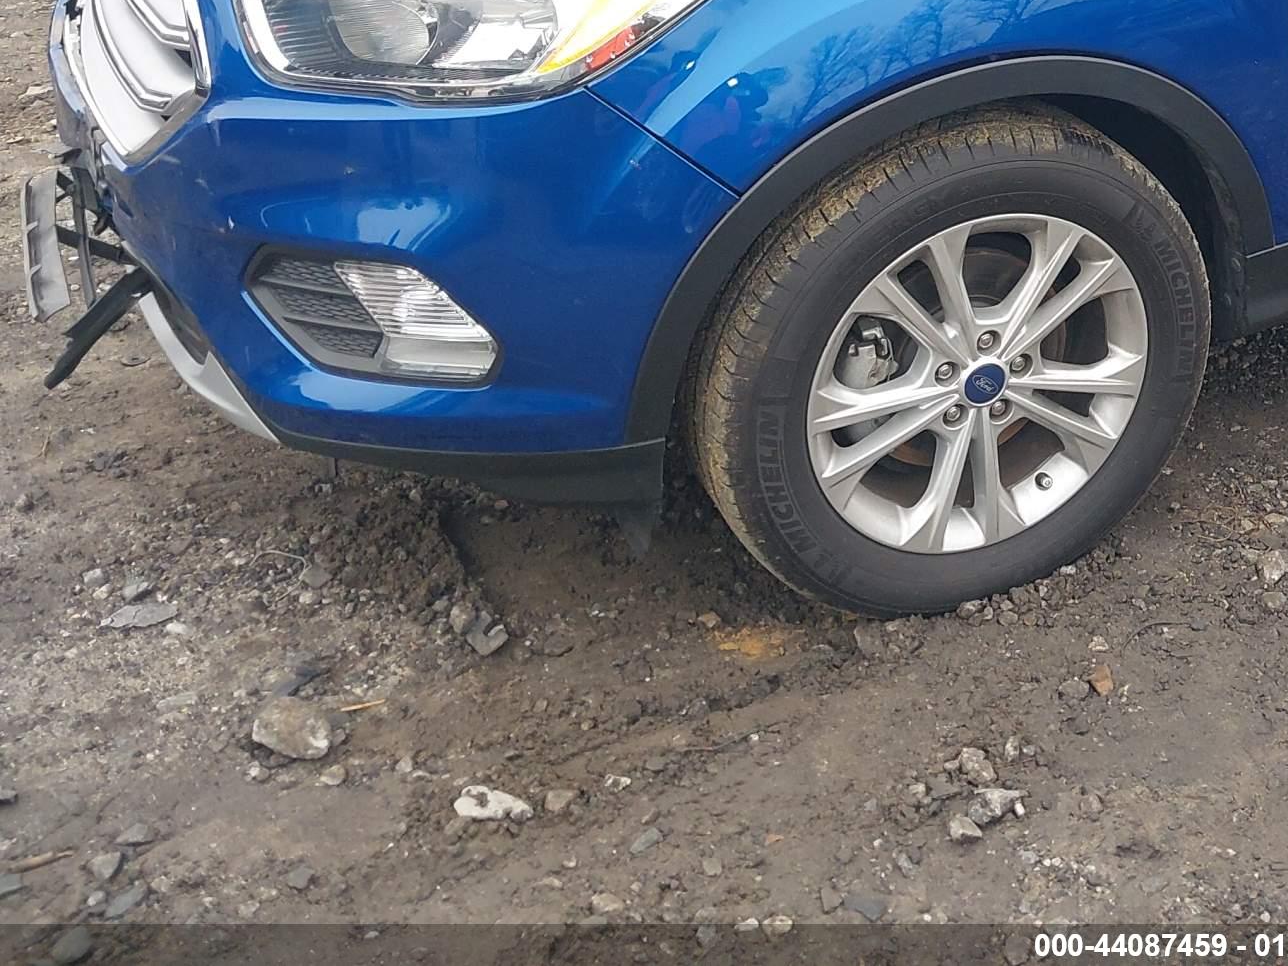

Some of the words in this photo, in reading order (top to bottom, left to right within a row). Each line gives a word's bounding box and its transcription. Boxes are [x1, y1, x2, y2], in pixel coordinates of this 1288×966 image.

[1155, 234, 1197, 376] MICHELIN
[974, 376, 996, 393] Ford
[757, 407, 816, 555] MICHELIN
